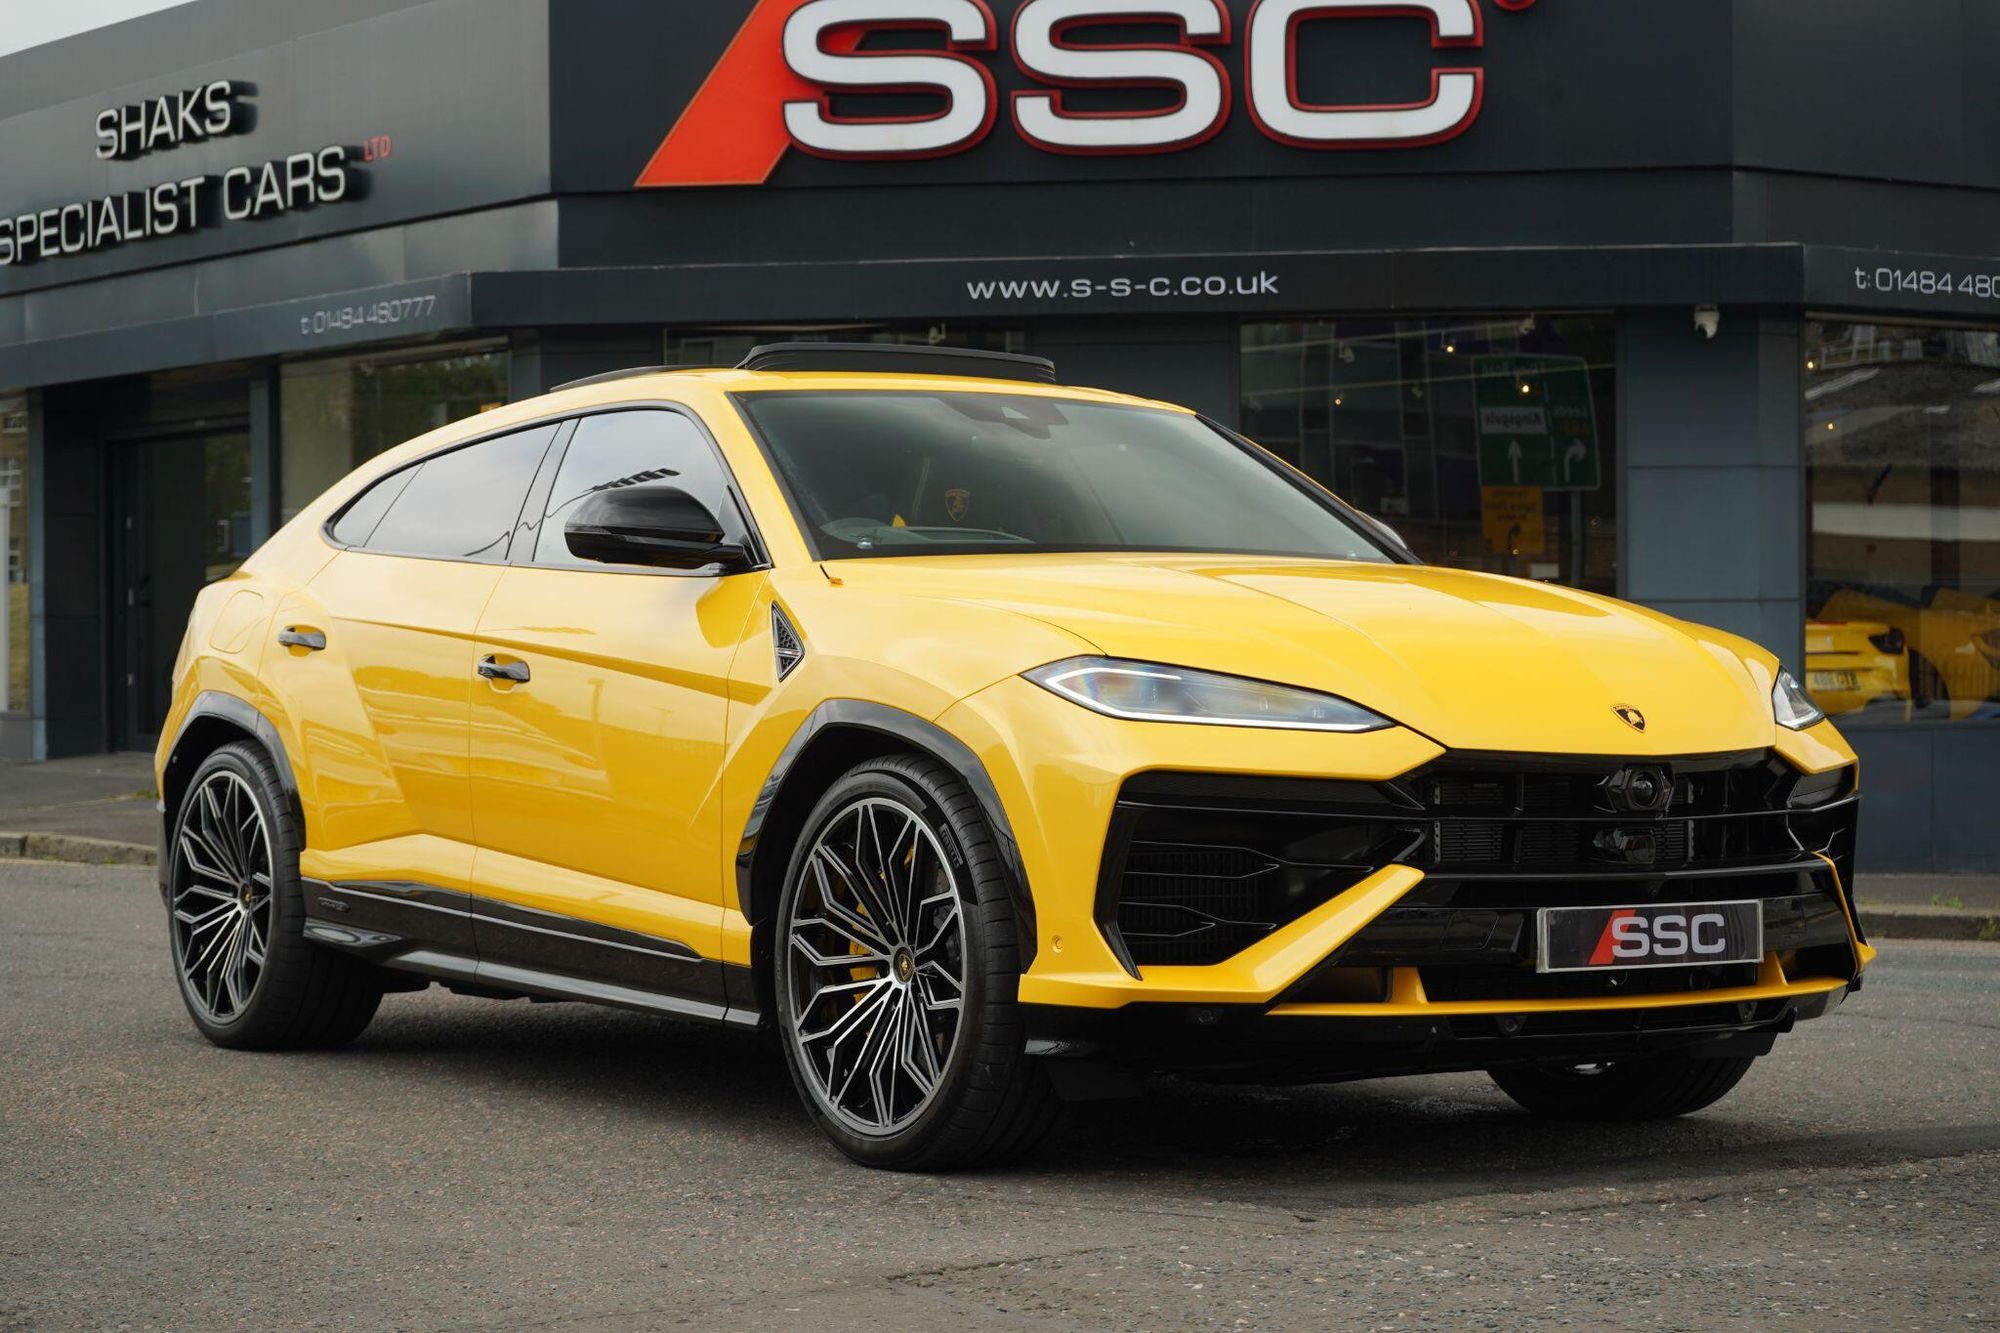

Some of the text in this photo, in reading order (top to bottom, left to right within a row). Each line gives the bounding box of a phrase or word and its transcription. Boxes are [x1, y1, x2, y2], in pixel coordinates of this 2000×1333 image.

[96, 80, 232, 160] SHAKS
[781, 0, 1485, 161] SSC
[0, 136, 392, 266] SPECIALIST CARS LTD
[967, 270, 1280, 299] www.s-s-c.co.uk
[1610, 913, 1727, 958] SSC
